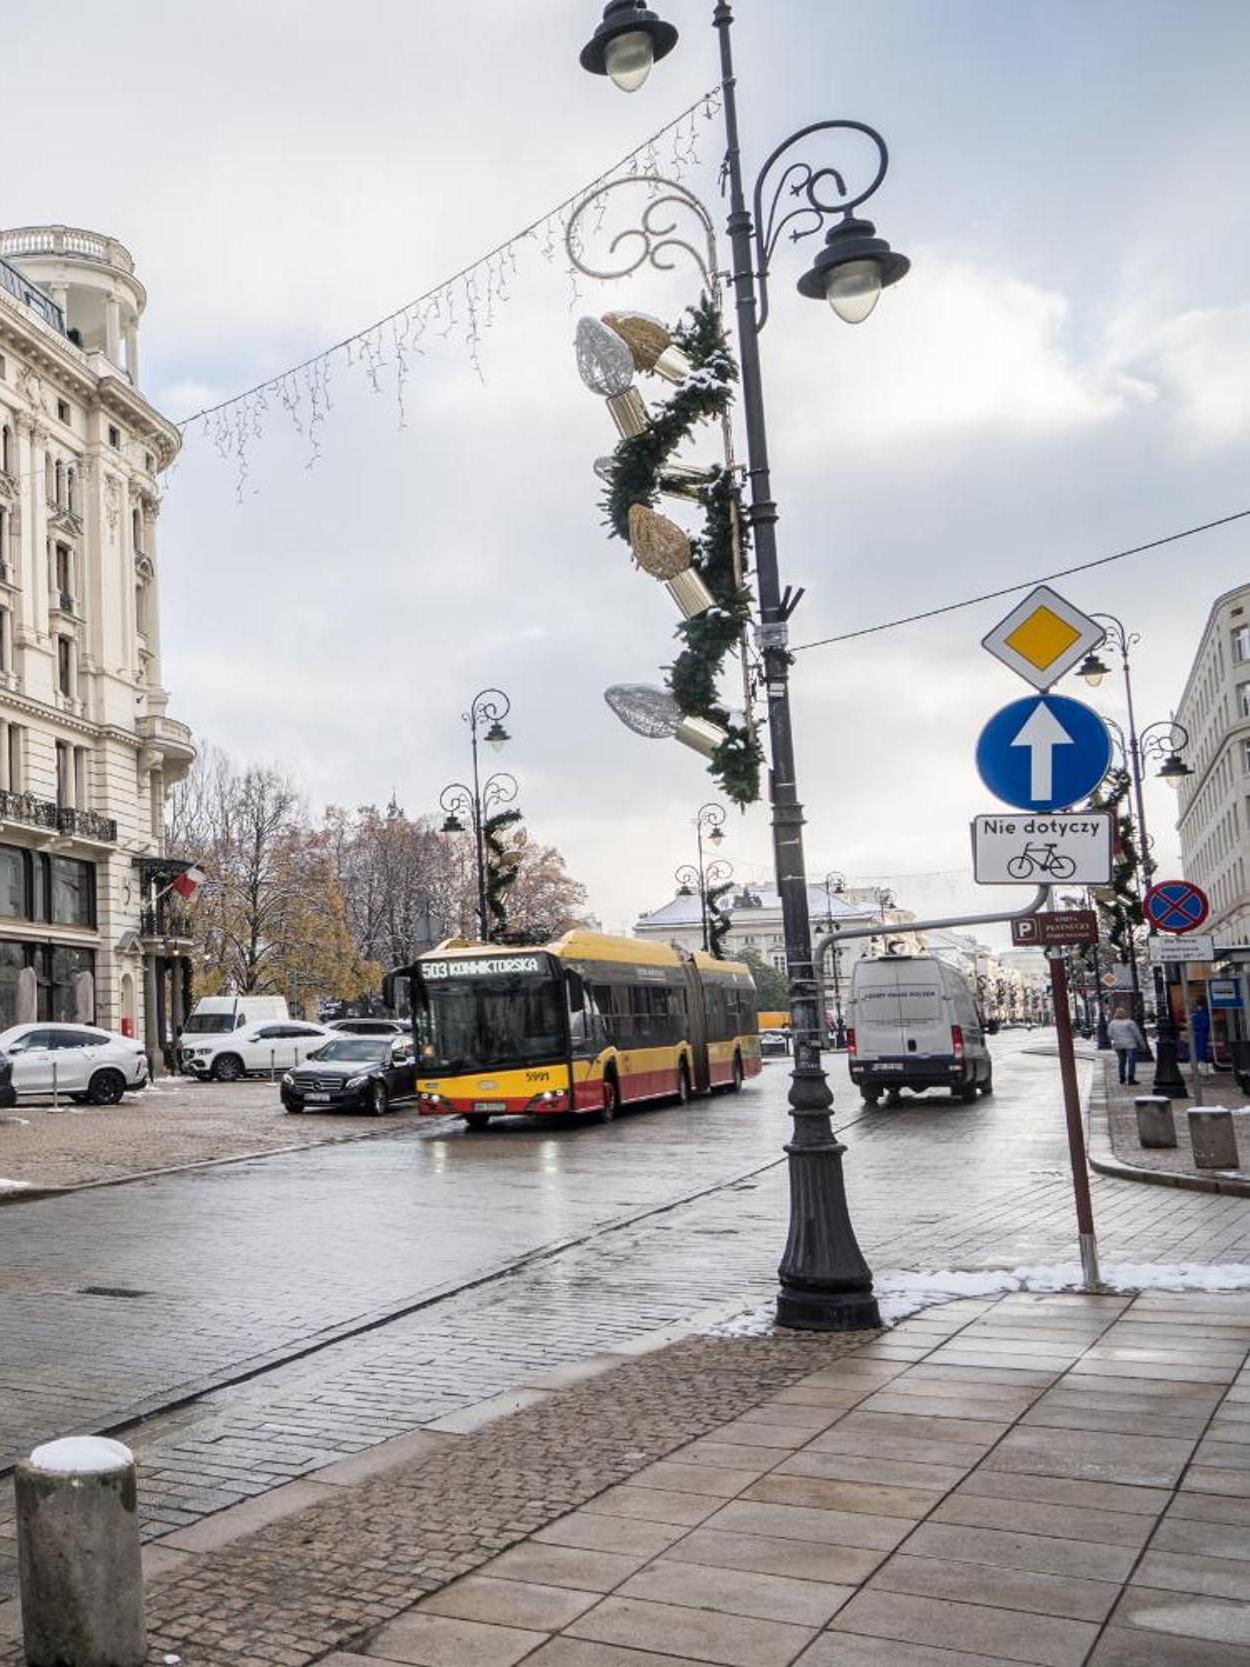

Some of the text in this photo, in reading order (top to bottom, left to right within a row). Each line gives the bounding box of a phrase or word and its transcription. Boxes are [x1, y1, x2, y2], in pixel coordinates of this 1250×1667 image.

[984, 819, 1099, 837] Nie dotyczy
[1019, 922, 1031, 938] P
[421, 958, 538, 979] 503 KONWIKTORSKA
